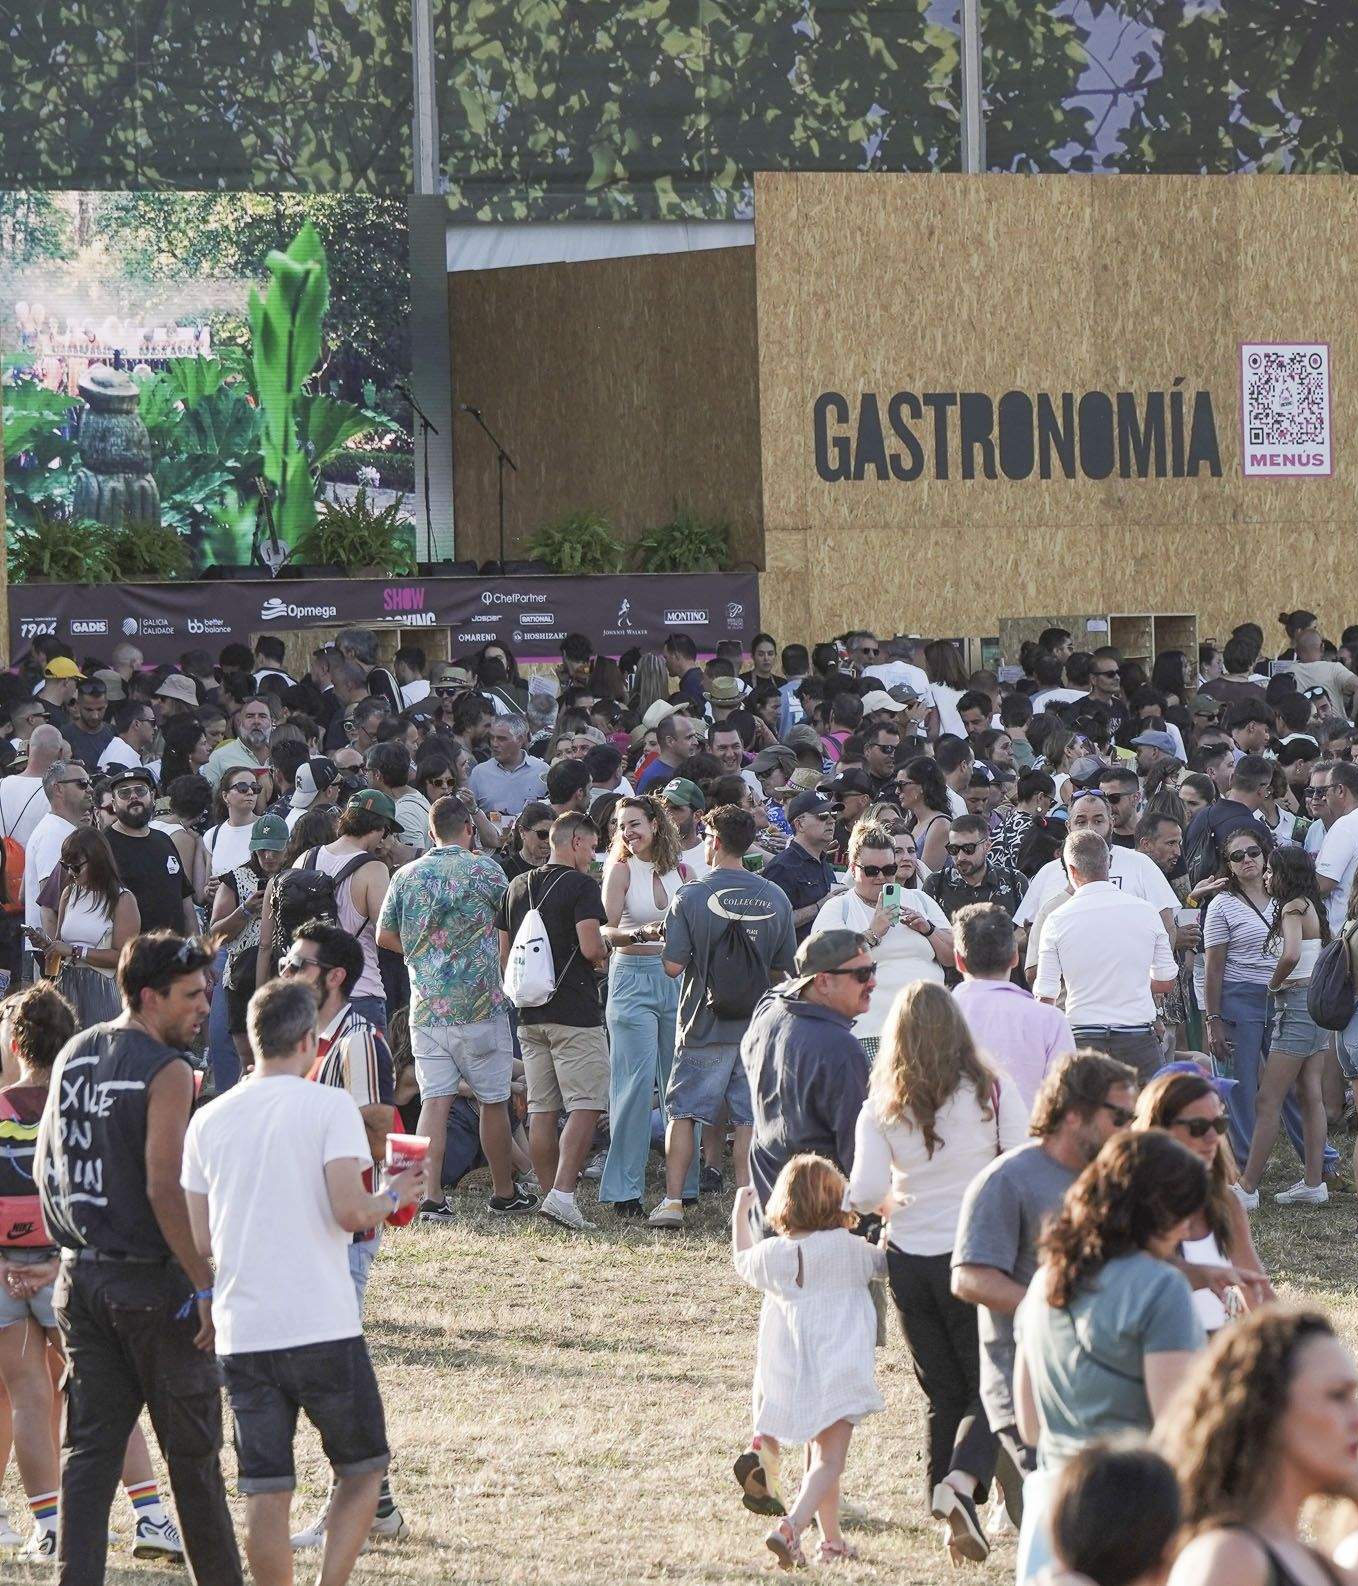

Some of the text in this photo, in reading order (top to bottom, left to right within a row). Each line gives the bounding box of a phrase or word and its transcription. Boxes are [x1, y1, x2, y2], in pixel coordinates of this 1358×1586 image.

[813, 376, 1223, 482] GASTRONOMÍA
[1249, 450, 1324, 467] MENÚS
[384, 587, 424, 610] SHOW
[493, 593, 547, 603] ChefPartner
[288, 604, 337, 619] Opmega
[204, 618, 224, 626] better
[521, 615, 553, 623] RATIONAL
[72, 622, 106, 633] GADIS
[143, 627, 175, 635] CALIDADE
[458, 633, 497, 642] OMARENO
[723, 898, 773, 909] COLLECTIVE
[12, 1222, 35, 1233] NIKE
